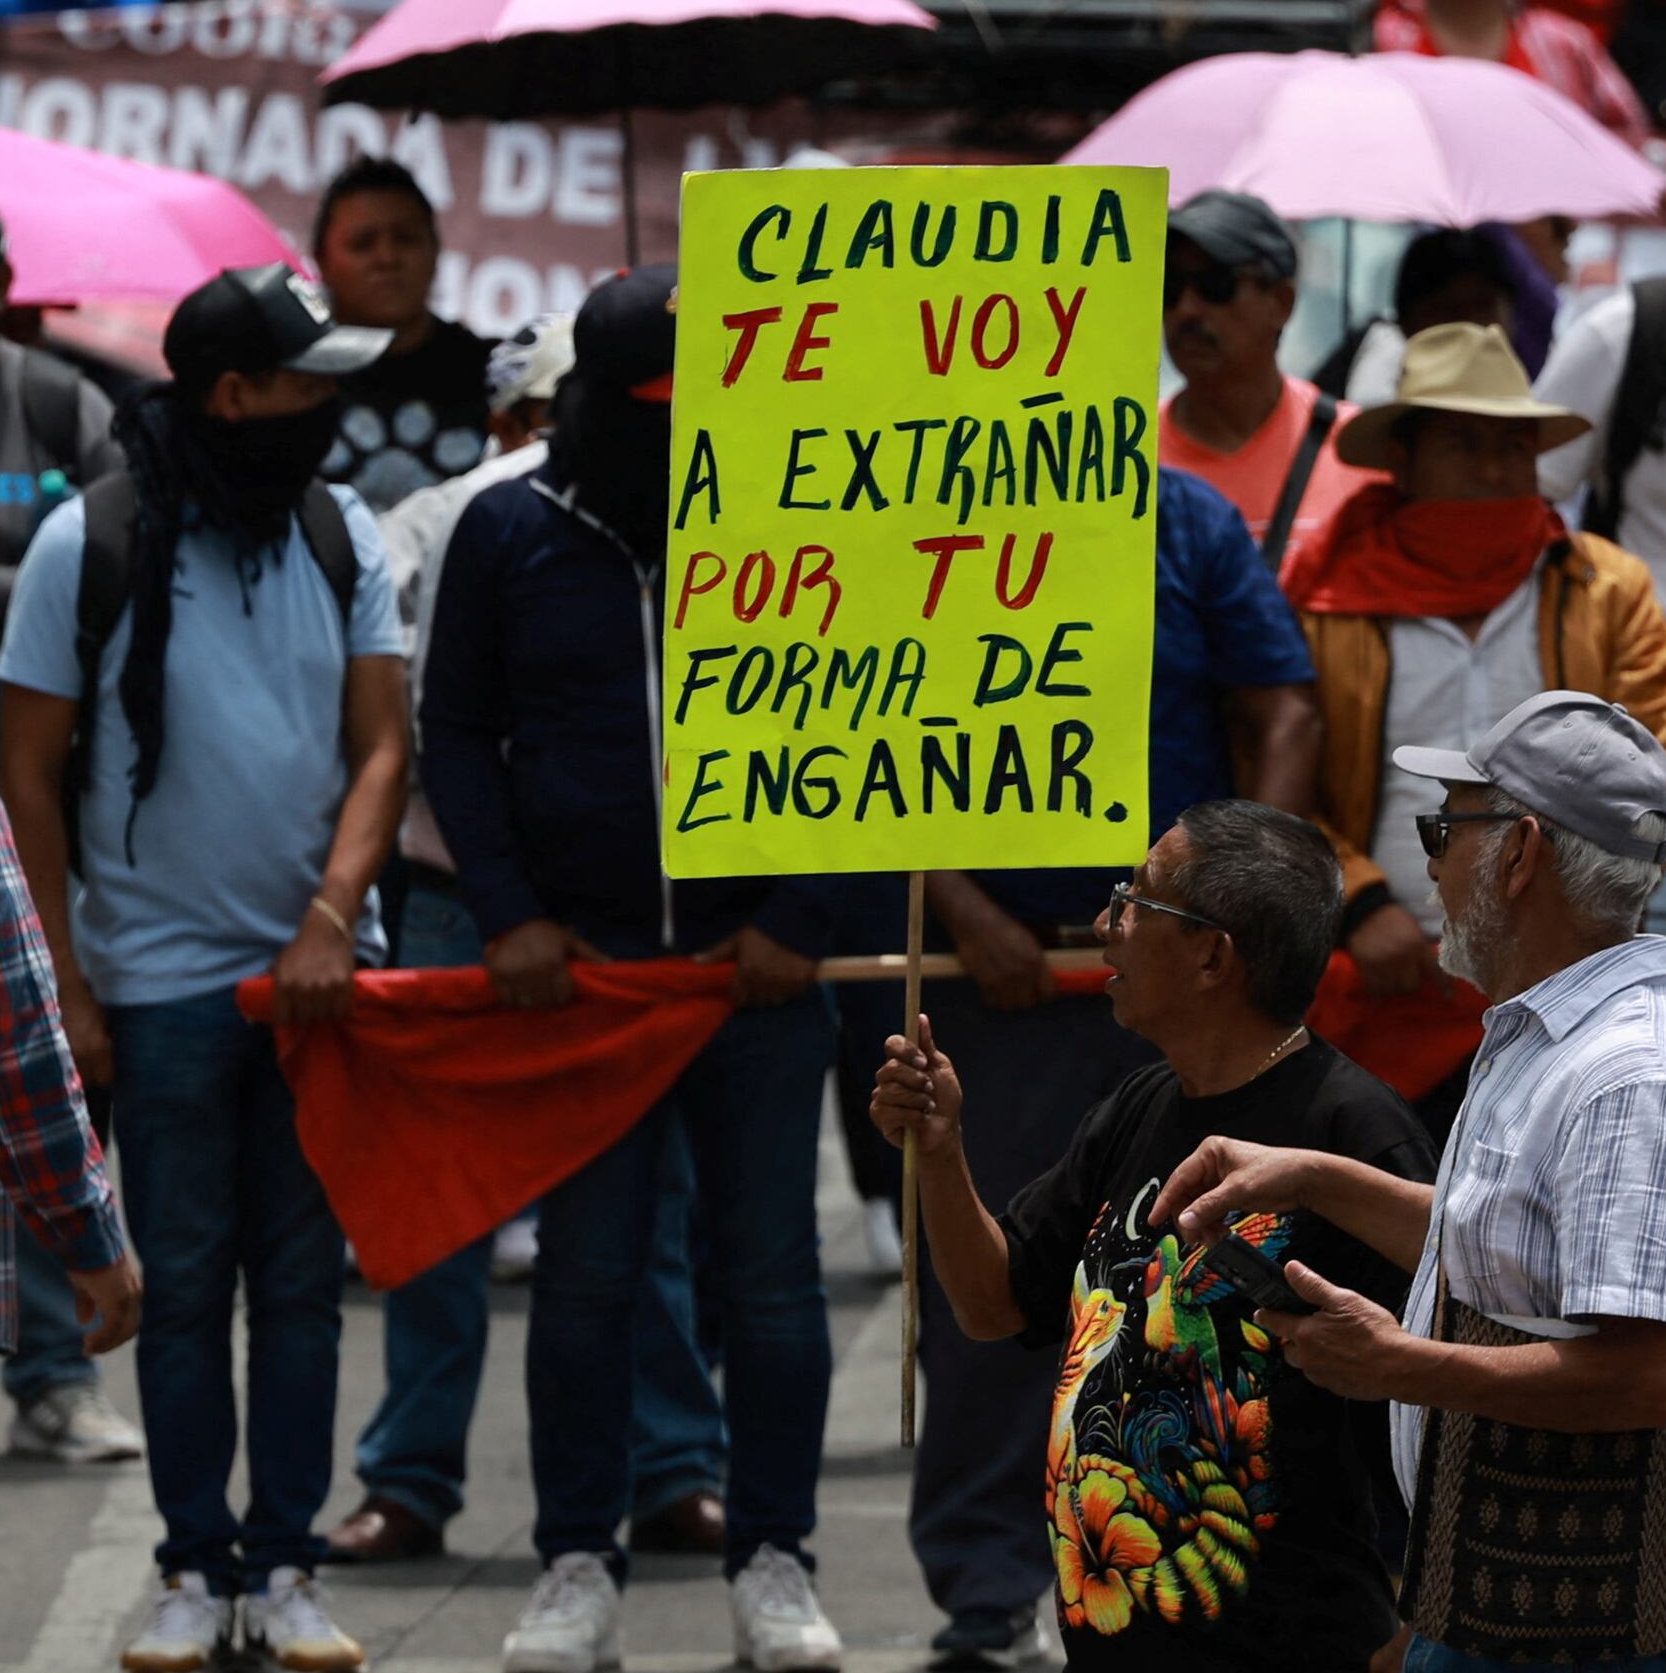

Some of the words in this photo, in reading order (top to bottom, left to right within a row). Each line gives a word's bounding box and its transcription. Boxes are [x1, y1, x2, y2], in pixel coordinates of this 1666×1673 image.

[479, 120, 622, 225] DE
[737, 189, 1132, 284] CLAUDIA
[721, 302, 839, 388] TE
[919, 286, 1087, 377] VOY
[674, 429, 721, 529] A
[778, 392, 1150, 525] EXTRAÑAR
[674, 545, 841, 636] POR
[913, 532, 1054, 620] TU
[674, 637, 926, 730] FORMA
[973, 622, 1094, 707] DE
[676, 717, 1129, 833] ENGAÑAR.
